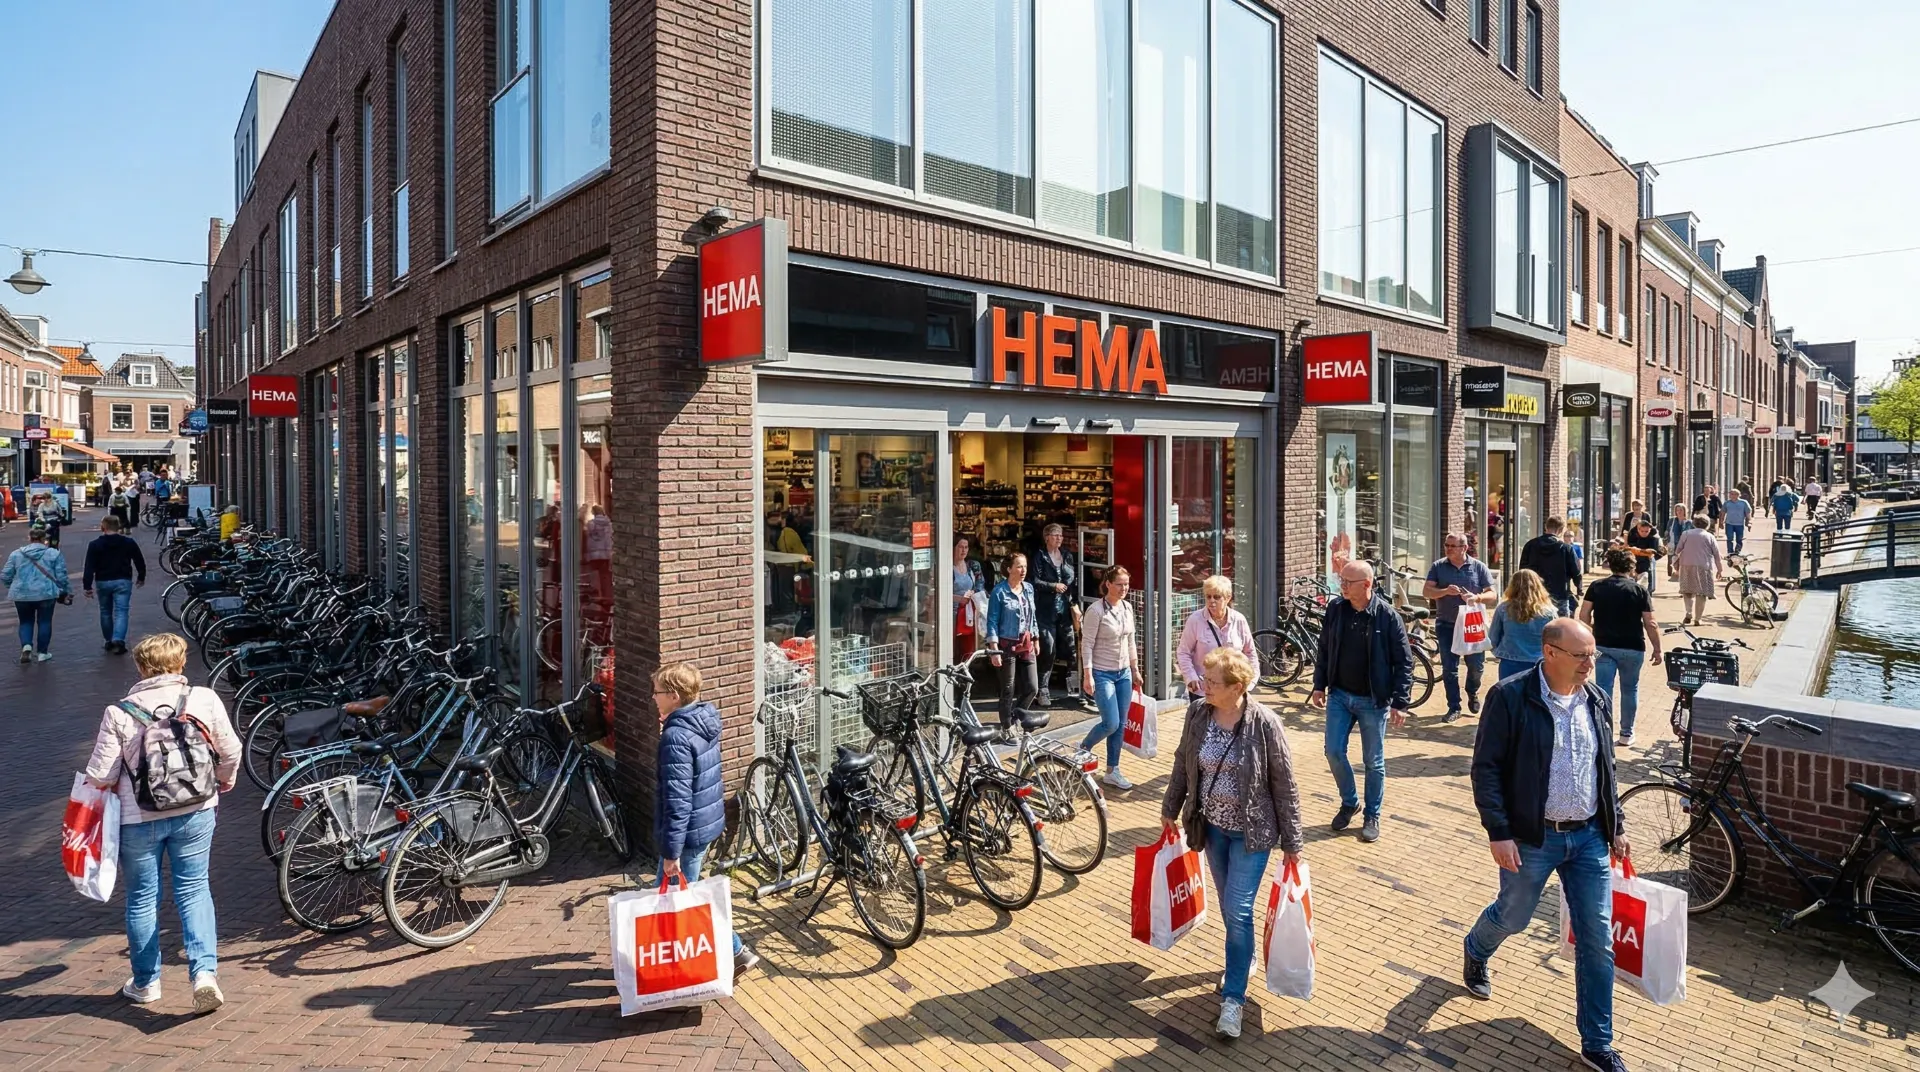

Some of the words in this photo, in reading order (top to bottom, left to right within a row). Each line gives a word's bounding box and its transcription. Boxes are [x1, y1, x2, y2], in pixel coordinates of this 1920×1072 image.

[703, 274, 762, 318] HEMA
[992, 306, 1169, 395] HEMA
[1306, 359, 1368, 380] HEMA
[252, 389, 297, 402] HEMA
[1170, 872, 1203, 908] HEMA
[638, 933, 714, 968] HEMA
[1611, 920, 1640, 950] MA
